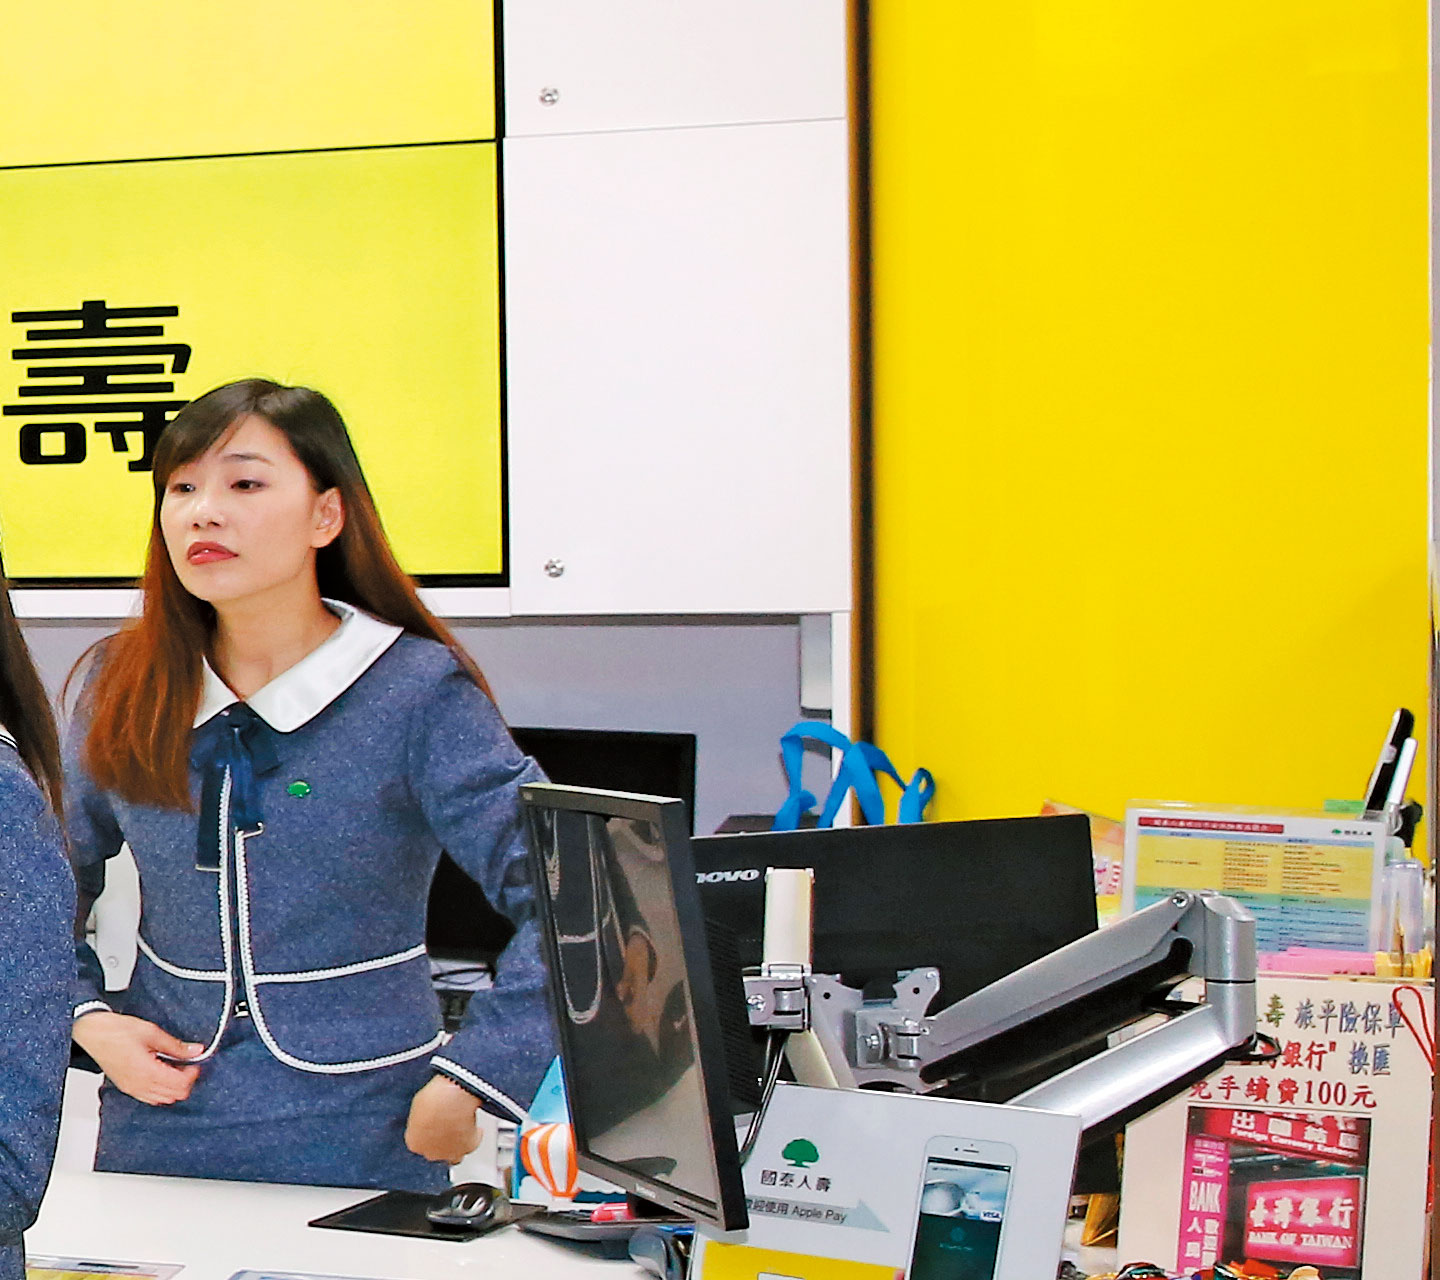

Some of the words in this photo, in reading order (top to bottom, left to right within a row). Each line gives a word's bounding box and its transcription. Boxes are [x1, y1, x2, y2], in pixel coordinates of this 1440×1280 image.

[1295, 999, 1405, 1039] 旅平險保單
[1348, 1039, 1391, 1077] 換匯
[760, 1169, 832, 1193] 國泰人壽
[1188, 1180, 1223, 1214] BANK
[791, 1206, 823, 1221] Apple
[825, 1209, 848, 1224] Pay
[981, 1209, 1002, 1220] VISA
